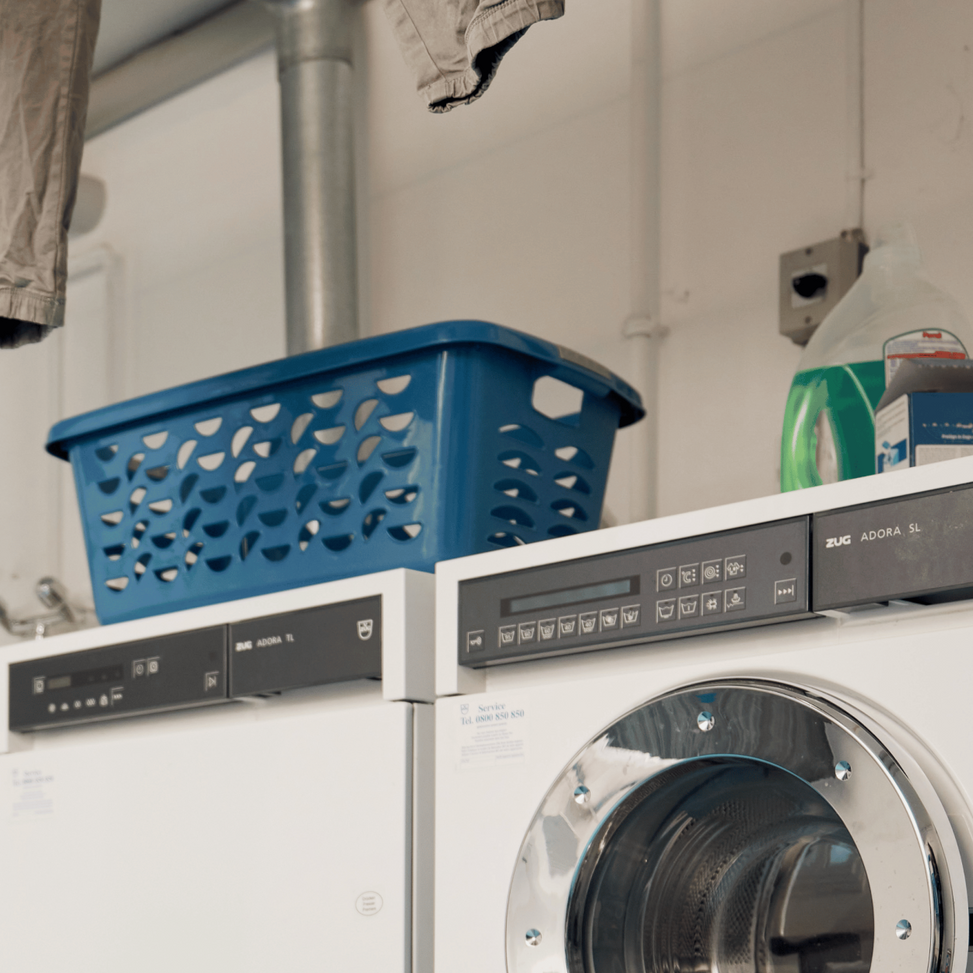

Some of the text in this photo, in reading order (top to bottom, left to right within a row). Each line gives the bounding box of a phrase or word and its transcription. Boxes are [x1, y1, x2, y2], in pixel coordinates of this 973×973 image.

[825, 523, 921, 548] ZUG ADORA SL
[235, 633, 295, 652] ZUG ADORA TL
[478, 702, 506, 713] Service
[475, 713, 494, 723] 0800
[495, 711, 509, 721] 850
[510, 709, 525, 719] 850
